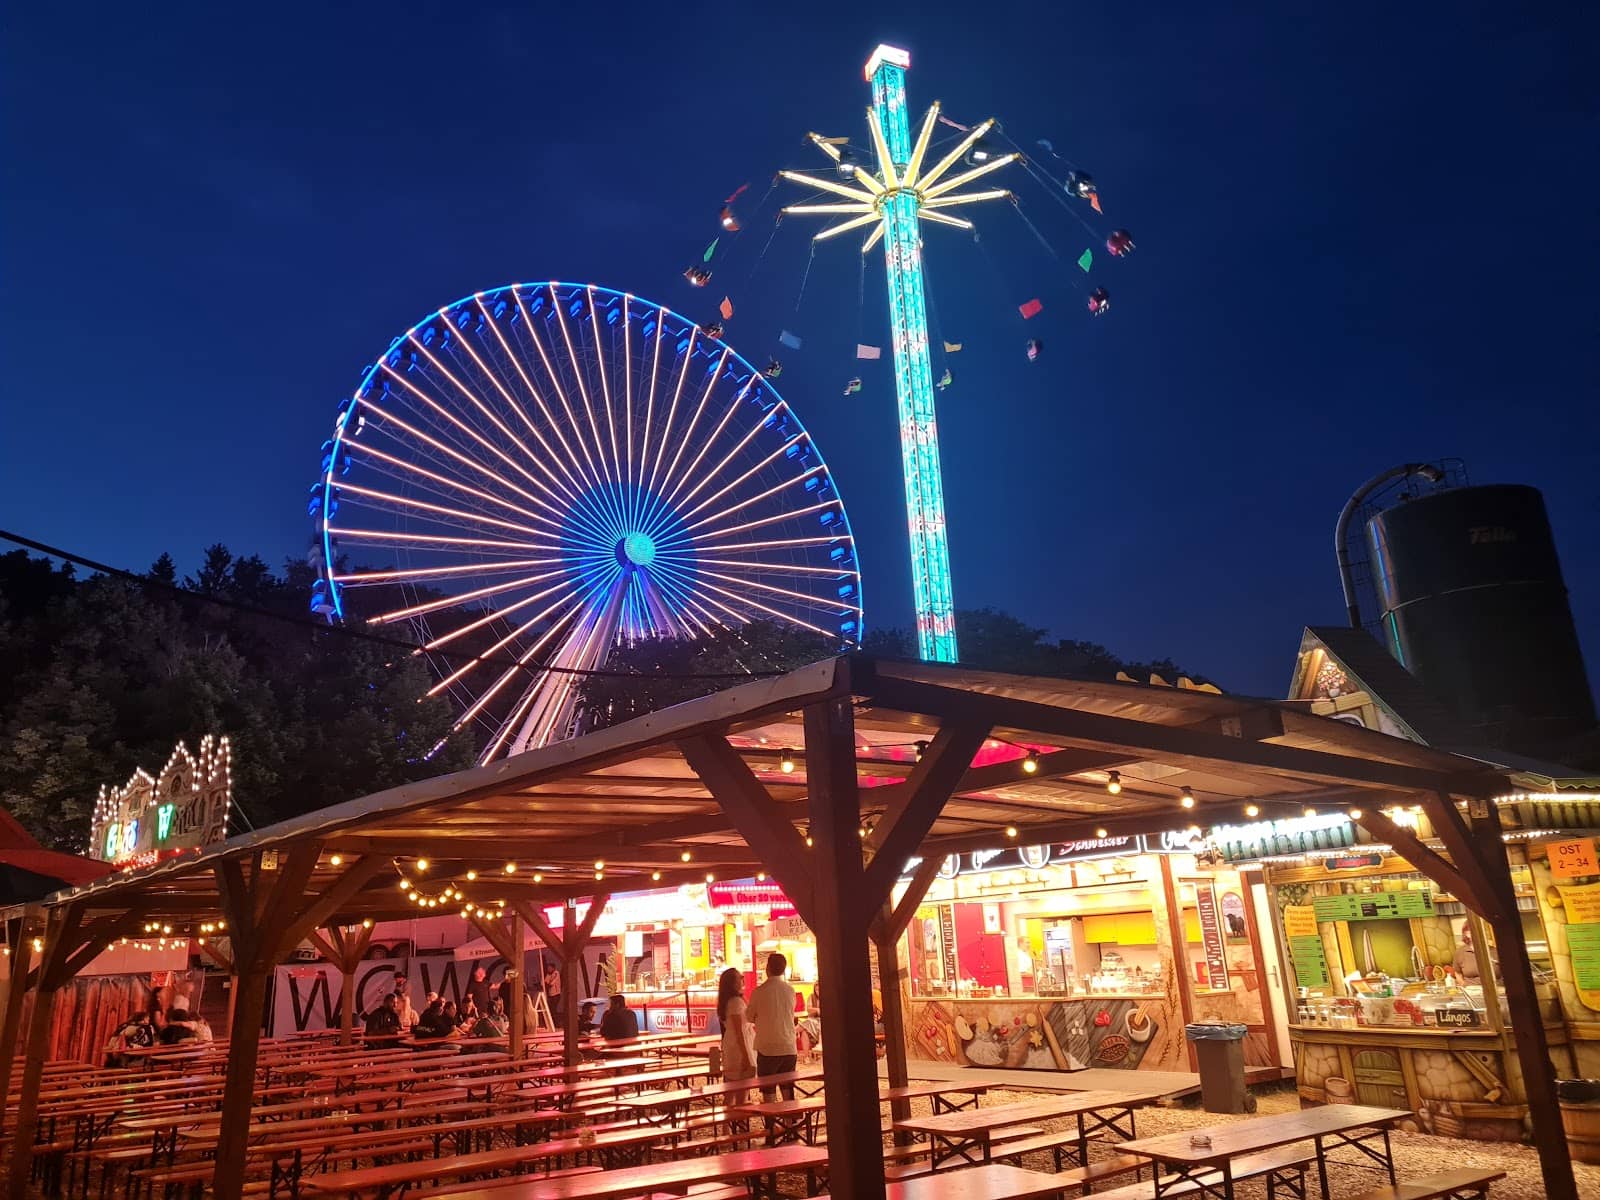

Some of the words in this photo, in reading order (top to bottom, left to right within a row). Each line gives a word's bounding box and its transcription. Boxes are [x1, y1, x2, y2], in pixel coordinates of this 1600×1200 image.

[1559, 844, 1581, 855] OST
[1558, 859, 1566, 869] 2
[1576, 857, 1590, 868] 34
[656, 1014, 706, 1027] CURRYWRST
[1439, 1010, 1472, 1026] Lángos
